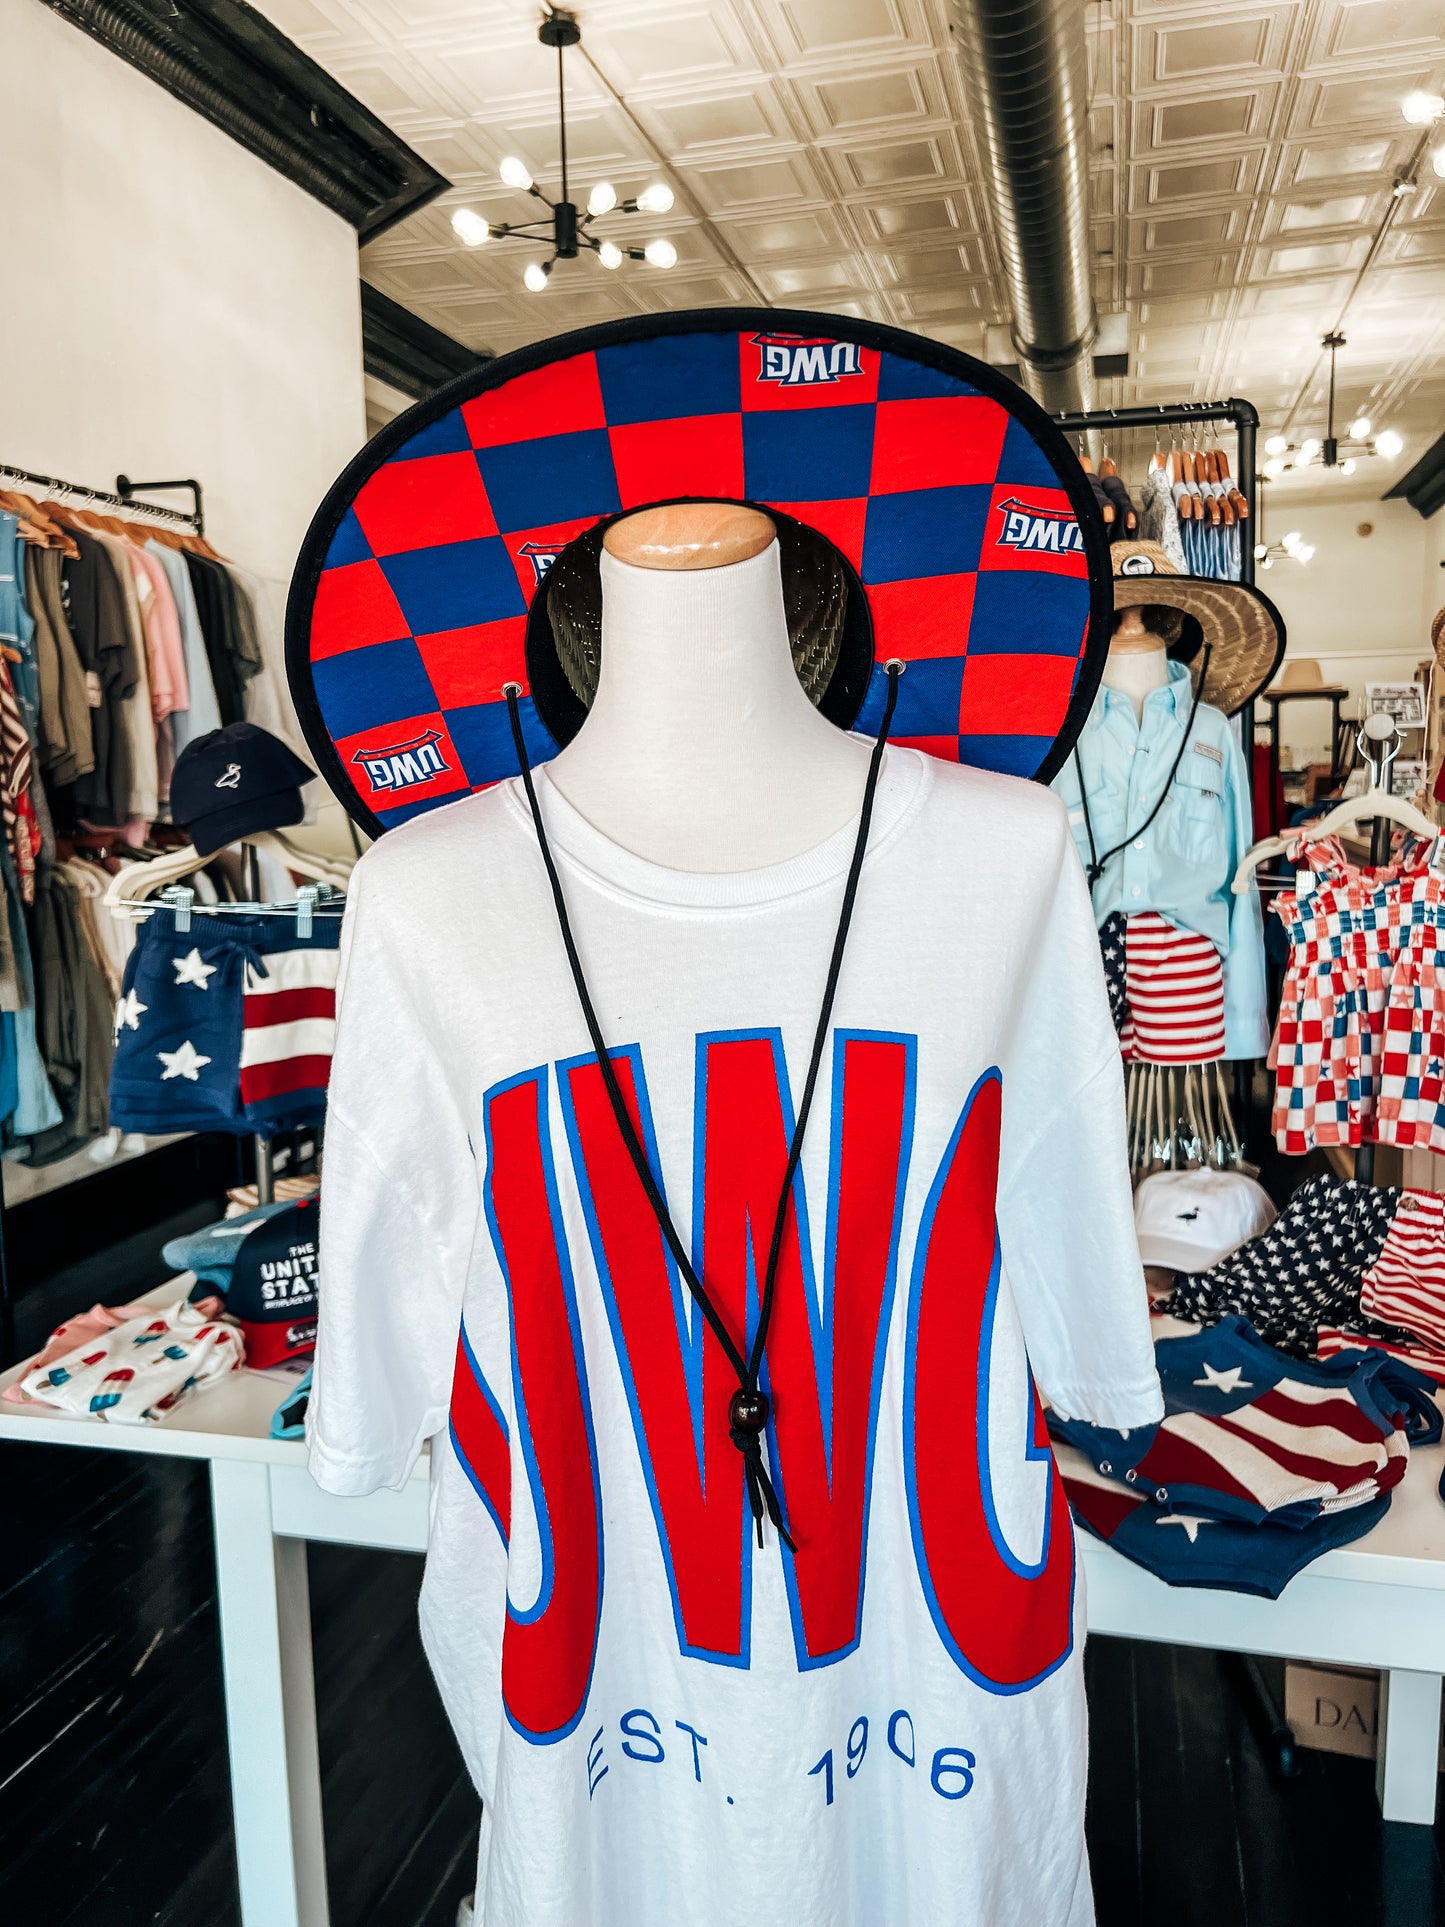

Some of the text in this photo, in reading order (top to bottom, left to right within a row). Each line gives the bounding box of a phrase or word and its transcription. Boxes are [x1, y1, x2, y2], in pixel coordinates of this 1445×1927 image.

[766, 341, 856, 383] UWG
[1005, 511, 1084, 551] UWG
[366, 743, 444, 787] UWG
[260, 1253, 319, 1281] UNIT
[289, 1242, 315, 1257] THE
[1315, 1697, 1378, 1736] DA
[586, 1708, 977, 1806] EST. 1906
